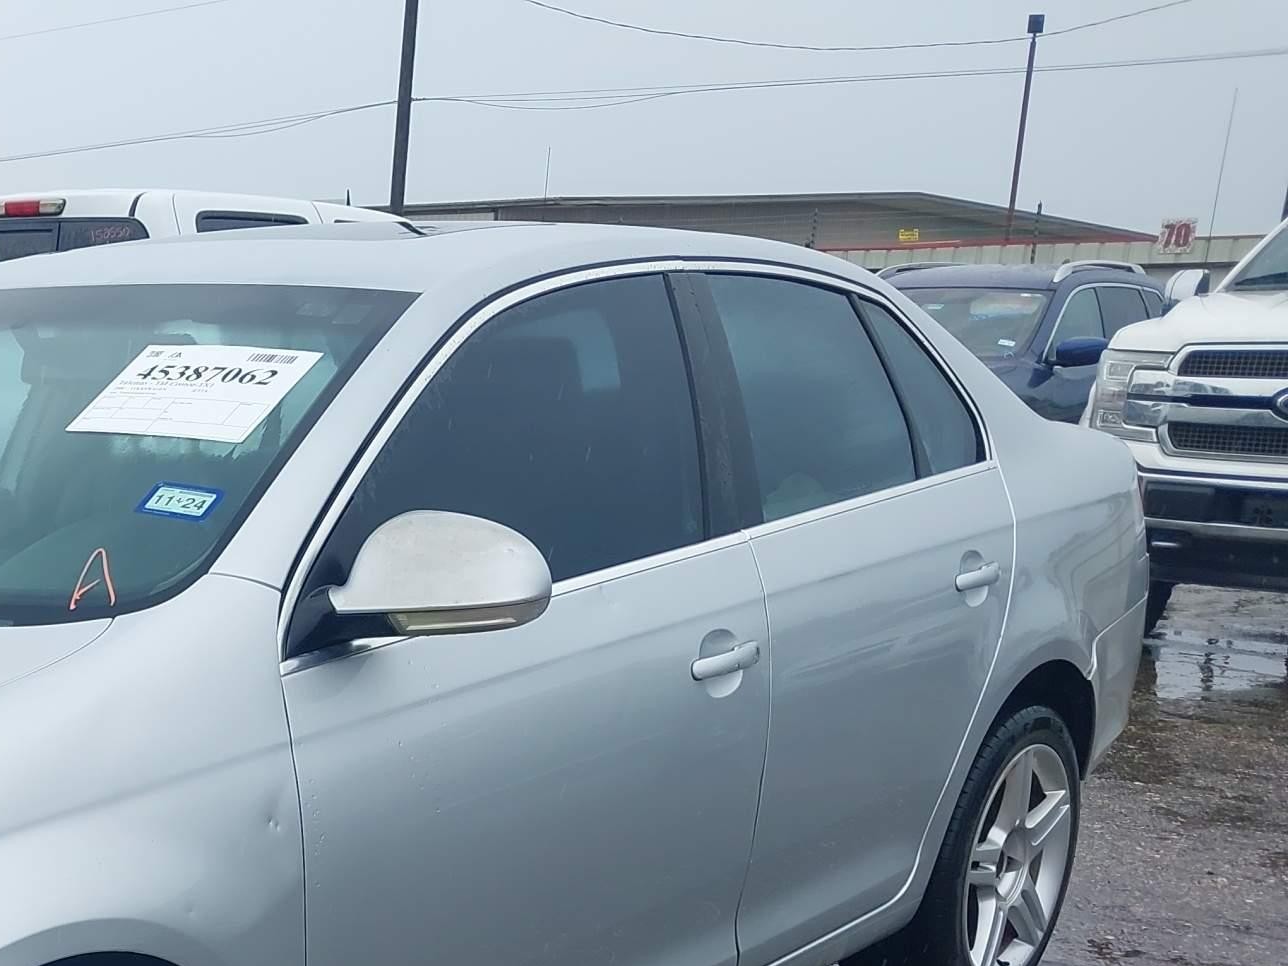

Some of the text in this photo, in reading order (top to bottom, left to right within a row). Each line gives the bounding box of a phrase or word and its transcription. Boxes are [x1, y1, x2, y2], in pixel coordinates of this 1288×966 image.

[1163, 223, 1192, 248] 70
[136, 364, 279, 386] 45387062
[69, 547, 116, 611] A
